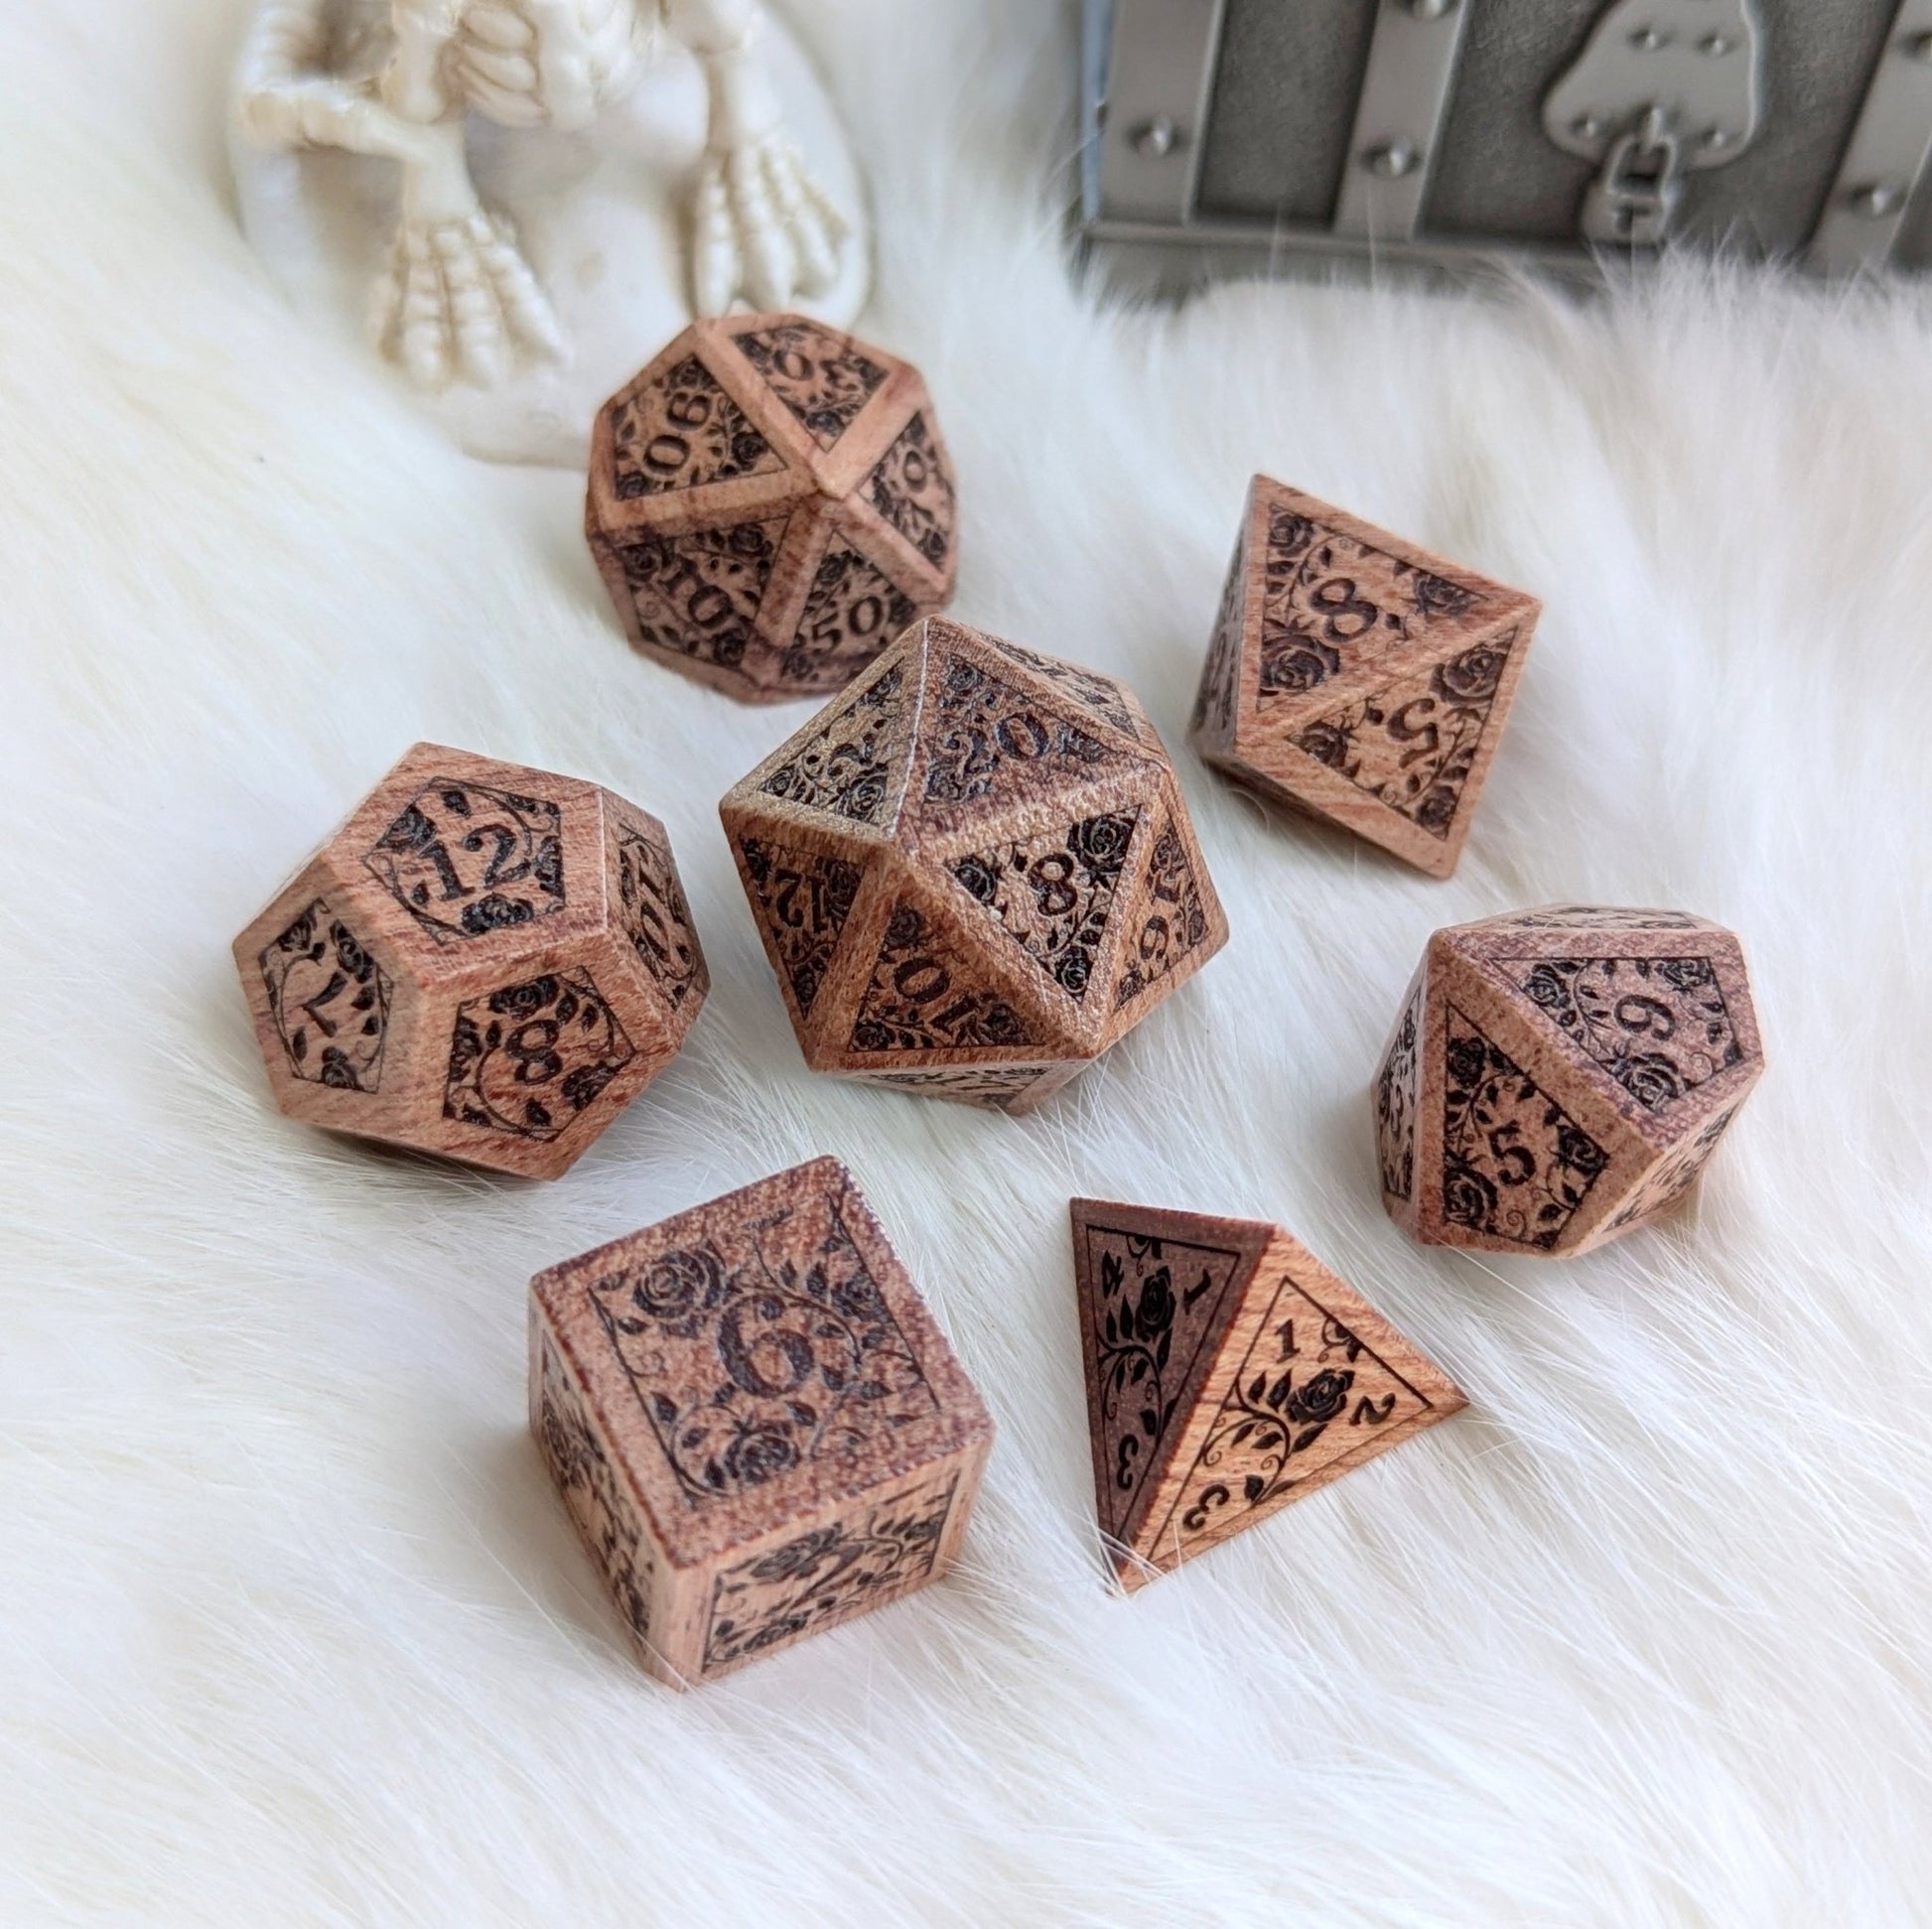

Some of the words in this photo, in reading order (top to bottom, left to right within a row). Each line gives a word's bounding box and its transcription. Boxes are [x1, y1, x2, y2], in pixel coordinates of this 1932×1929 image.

[810, 596, 883, 654] 50
[1311, 578, 1378, 642] 8
[946, 712, 1050, 781] 20
[1387, 698, 1439, 769] 5
[419, 823, 532, 902] 12
[1028, 853, 1078, 916] 8
[637, 858, 673, 964] 10
[774, 868, 829, 934] 12
[301, 971, 348, 1038] 7
[894, 956, 984, 1035] 10
[505, 1019, 563, 1086] 8
[1490, 1121, 1537, 1186] 5
[1100, 1250, 1125, 1301] 4
[1182, 1269, 1212, 1315] 1
[718, 1294, 815, 1399] 6
[1275, 1317, 1302, 1365] 1
[1348, 1392, 1397, 1428] 2
[1117, 1434, 1139, 1491] 3
[1181, 1483, 1230, 1532] 3
